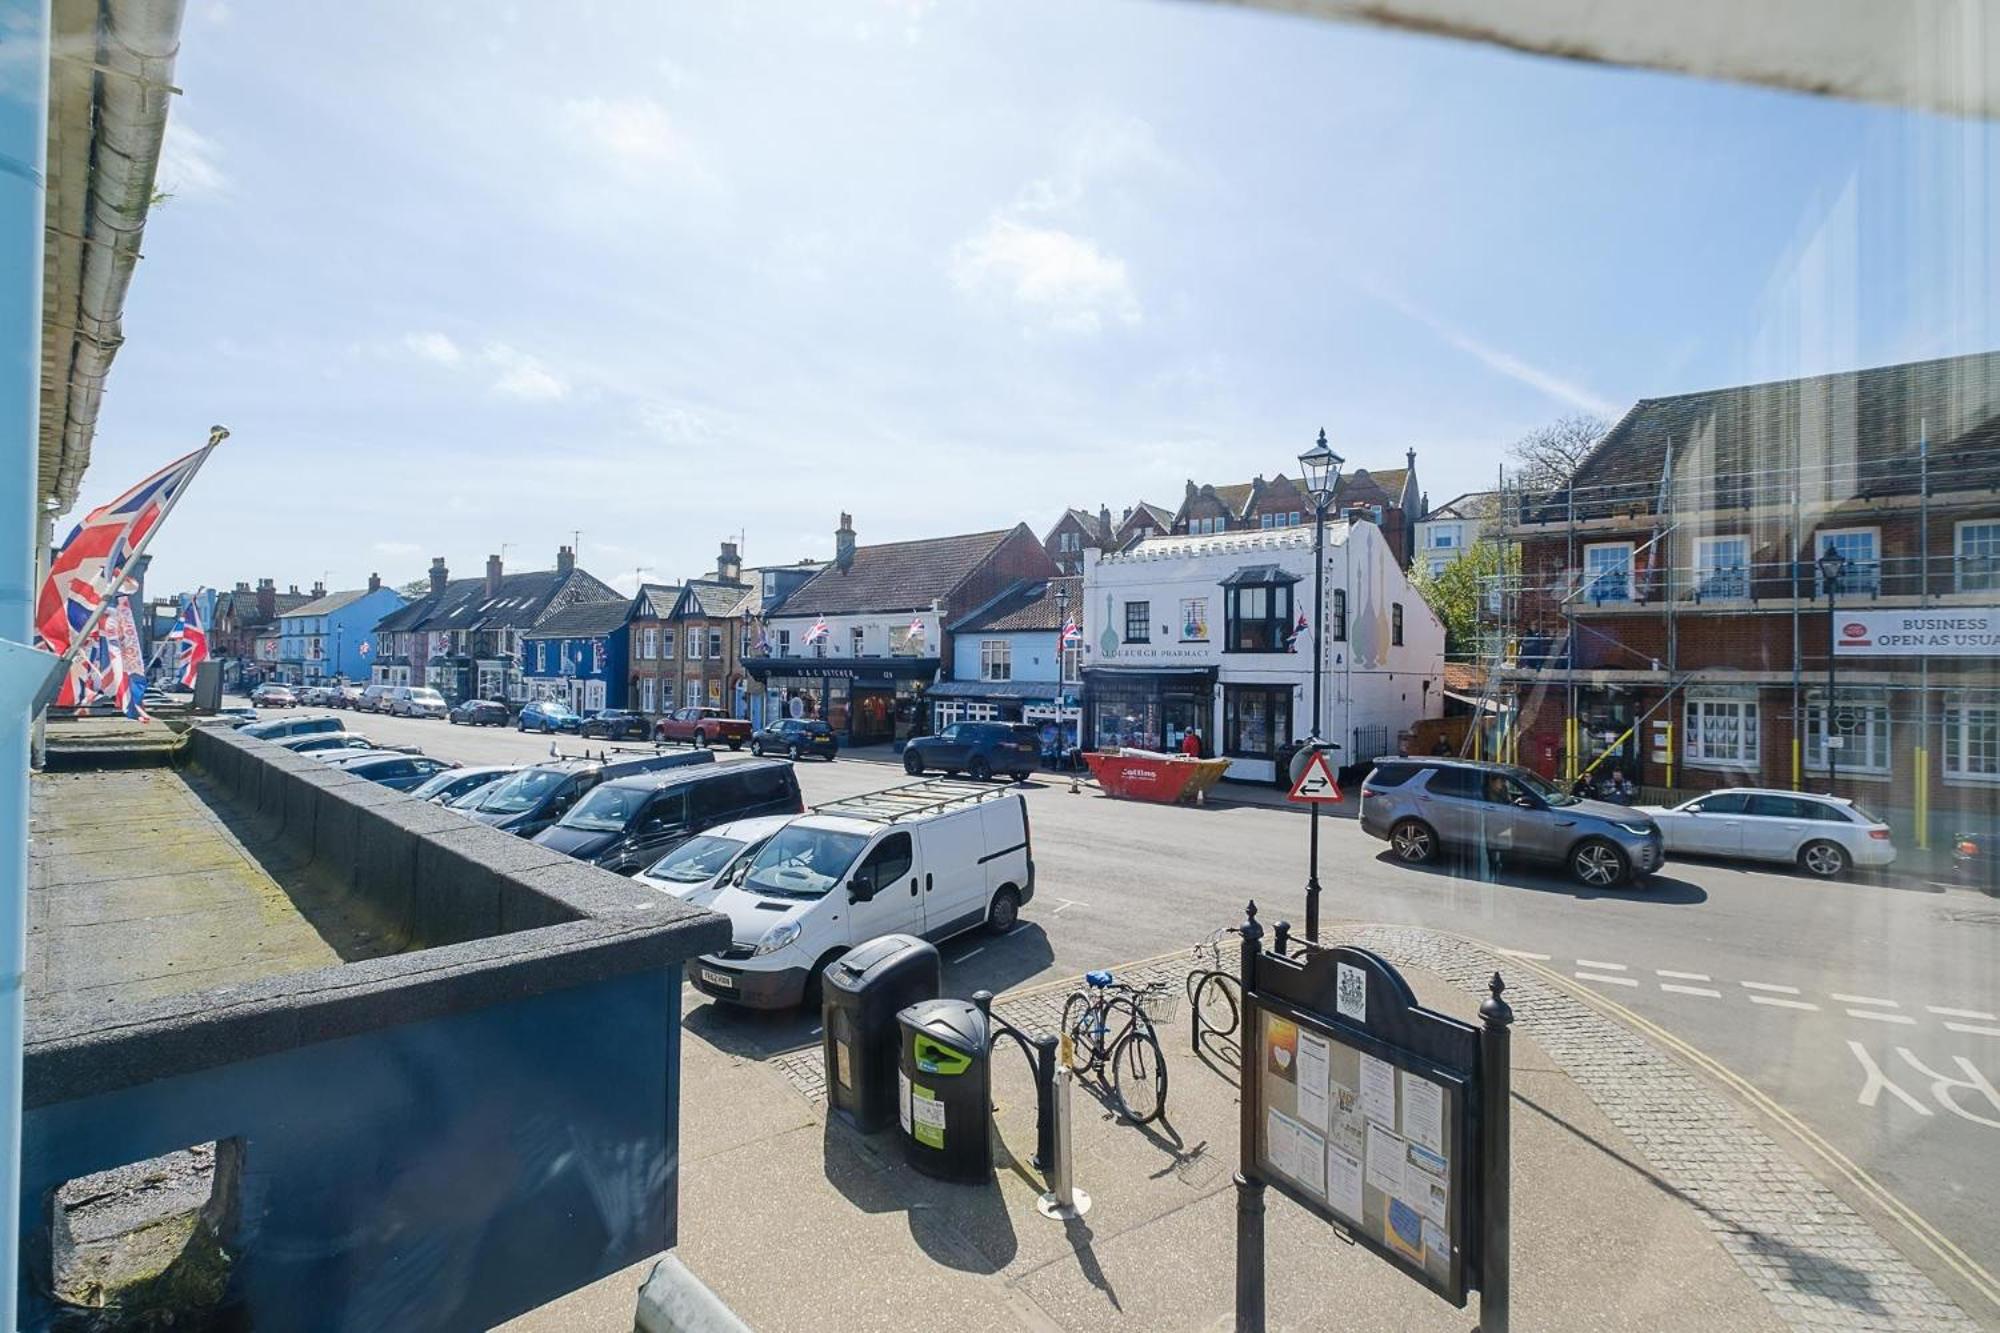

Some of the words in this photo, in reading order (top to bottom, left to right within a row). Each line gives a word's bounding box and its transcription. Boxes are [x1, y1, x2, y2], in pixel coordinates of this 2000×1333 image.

[1903, 618, 1988, 630] BUSINESS
[1878, 635, 1925, 646] OPEN
[1928, 635, 1950, 645] AS
[1161, 649, 1209, 657] PHARMACY
